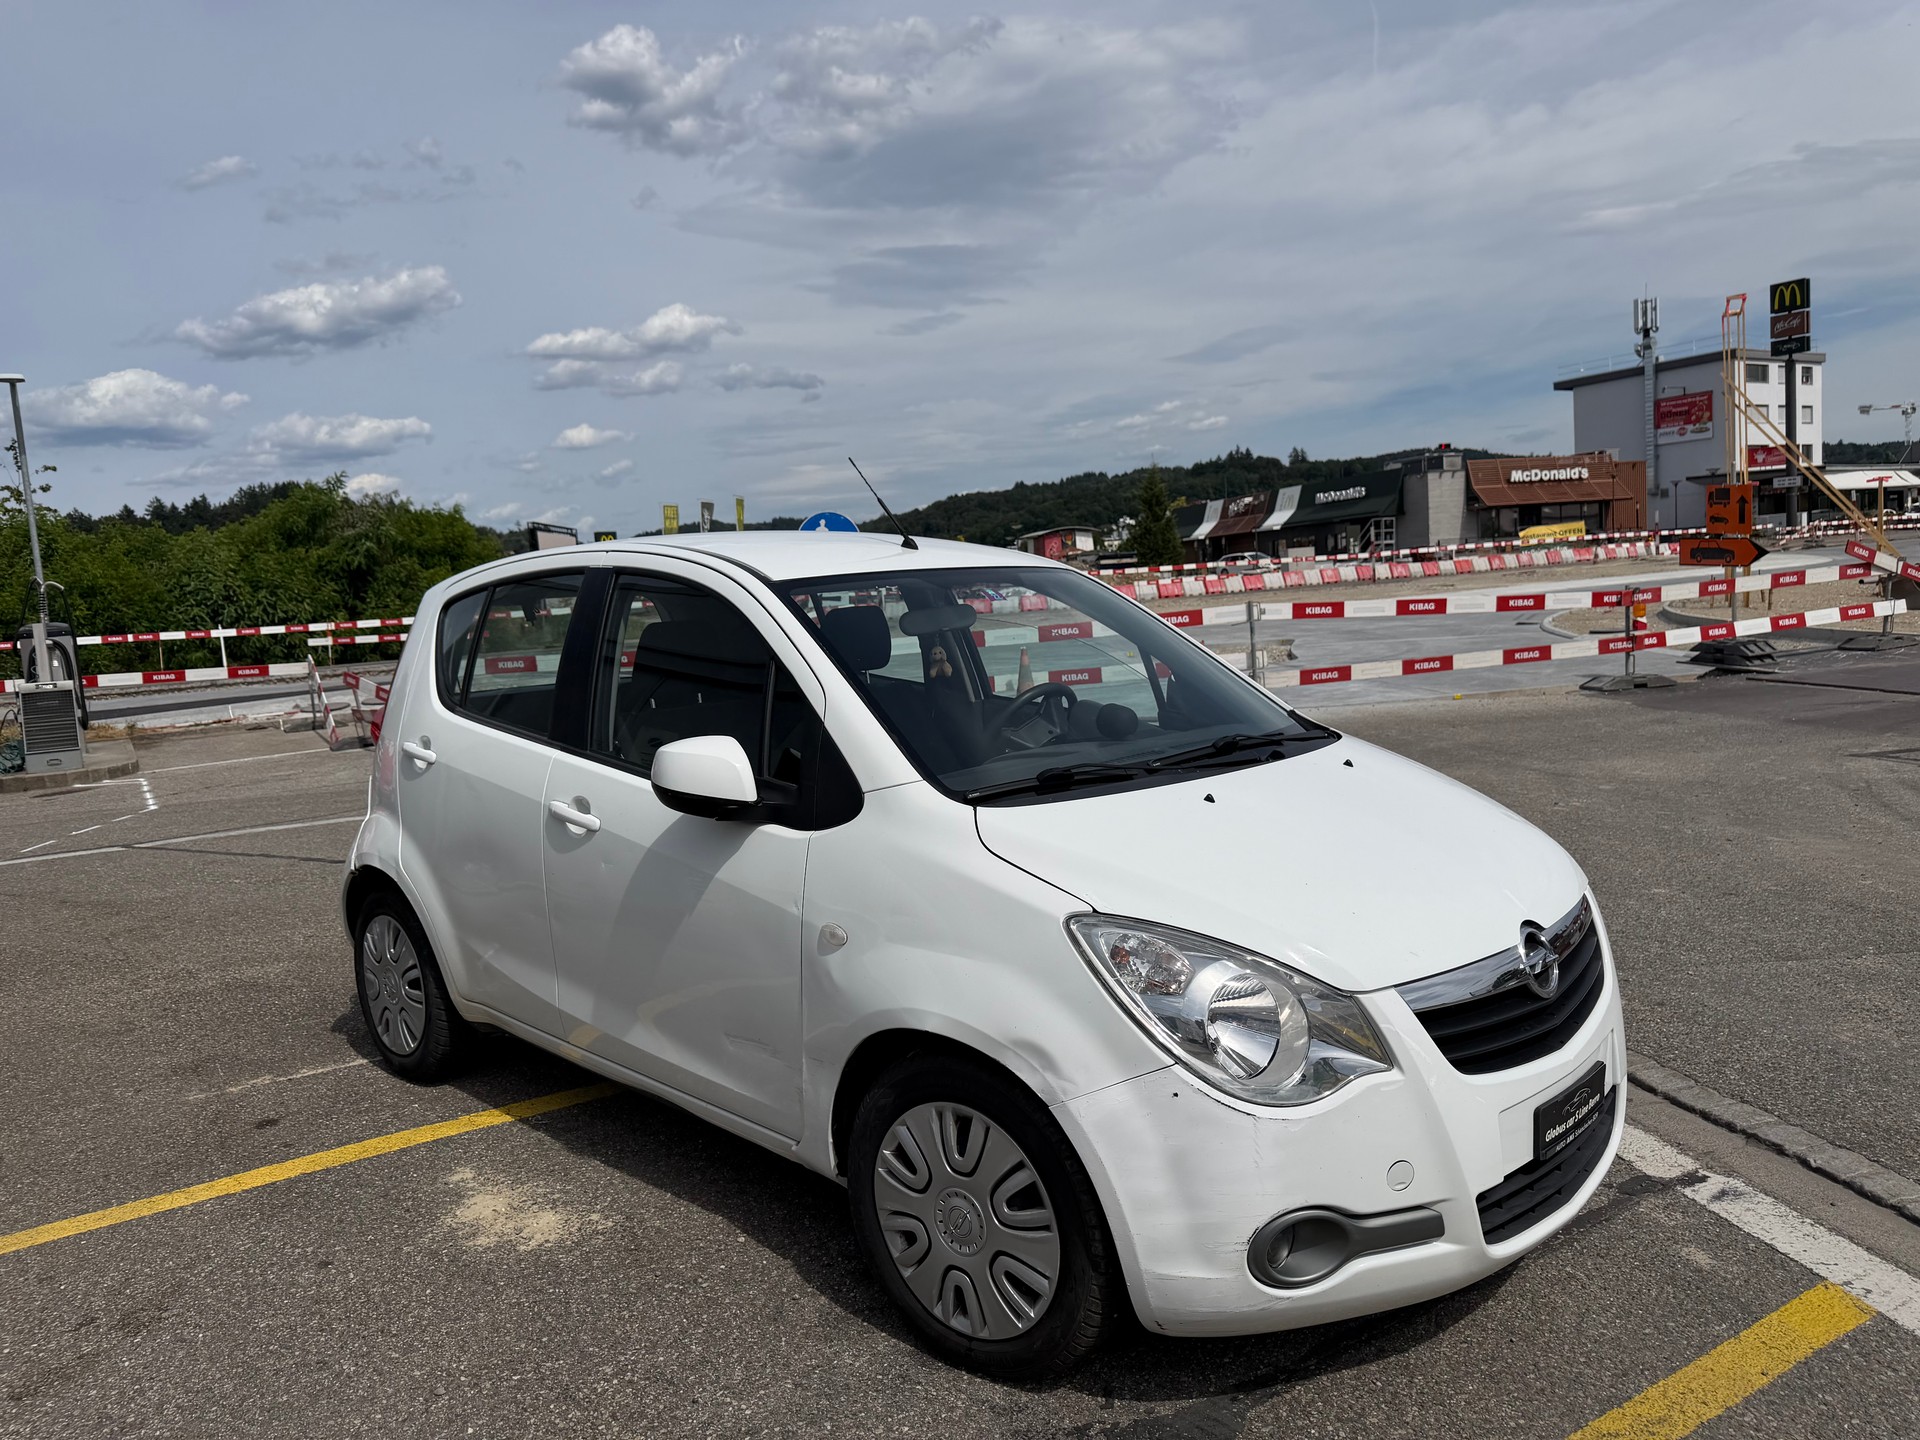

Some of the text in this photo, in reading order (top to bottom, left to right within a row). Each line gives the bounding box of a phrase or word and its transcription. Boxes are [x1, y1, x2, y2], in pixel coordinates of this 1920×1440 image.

[1510, 467, 1589, 483] McDonald's
[1558, 528, 1583, 537] OFFEN
[1853, 546, 1869, 557] KIBAG
[1846, 567, 1864, 576] KIBAG
[1779, 574, 1798, 584] KIBAG
[1707, 583, 1727, 592] KIBAG
[1508, 598, 1535, 607] KIBAG
[1603, 595, 1621, 603] KIB
[1305, 606, 1333, 615] KIBAG
[1408, 602, 1435, 611] KIBAG
[1848, 606, 1866, 616] KIBAG
[1778, 617, 1798, 627] KIBAG
[1708, 627, 1727, 637] KIBAG
[1609, 641, 1633, 650] KIBAG
[1643, 636, 1658, 646] BAG
[1514, 650, 1540, 660] KIBAG
[497, 661, 525, 669] KIBAG
[1414, 660, 1441, 670] KIBAG
[237, 668, 260, 676] KIBAG
[1312, 671, 1339, 681] KIBAG
[152, 673, 176, 681] KIBAG
[1061, 673, 1089, 682] KIBAG
[1545, 1122, 1567, 1142] Globus
[1566, 1115, 1576, 1128] car
[1579, 1104, 1589, 1119] Line
